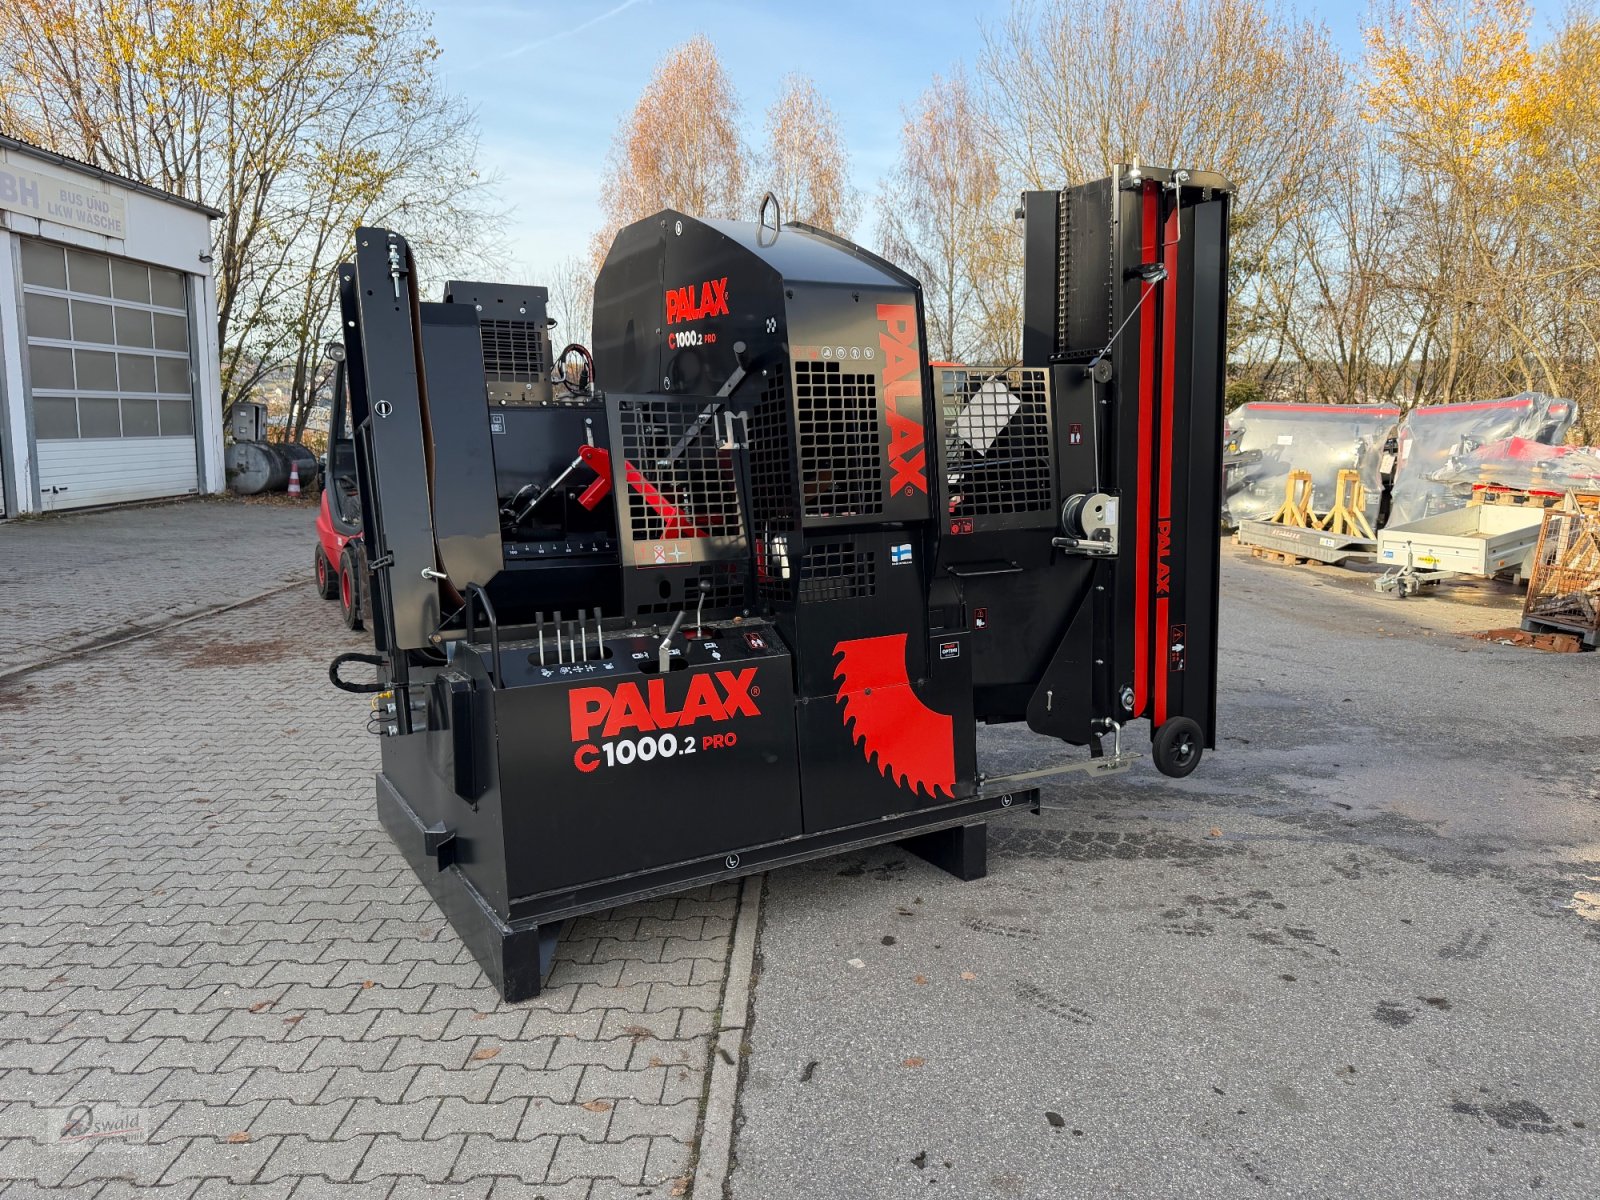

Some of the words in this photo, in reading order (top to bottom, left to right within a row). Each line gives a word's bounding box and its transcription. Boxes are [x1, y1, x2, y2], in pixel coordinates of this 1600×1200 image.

[60, 190, 83, 206] BUS
[87, 197, 109, 213] UND
[47, 201, 73, 220] LKW
[76, 208, 122, 232] WÄSCHE
[704, 333, 717, 344] PRO
[702, 732, 738, 751] PRO
